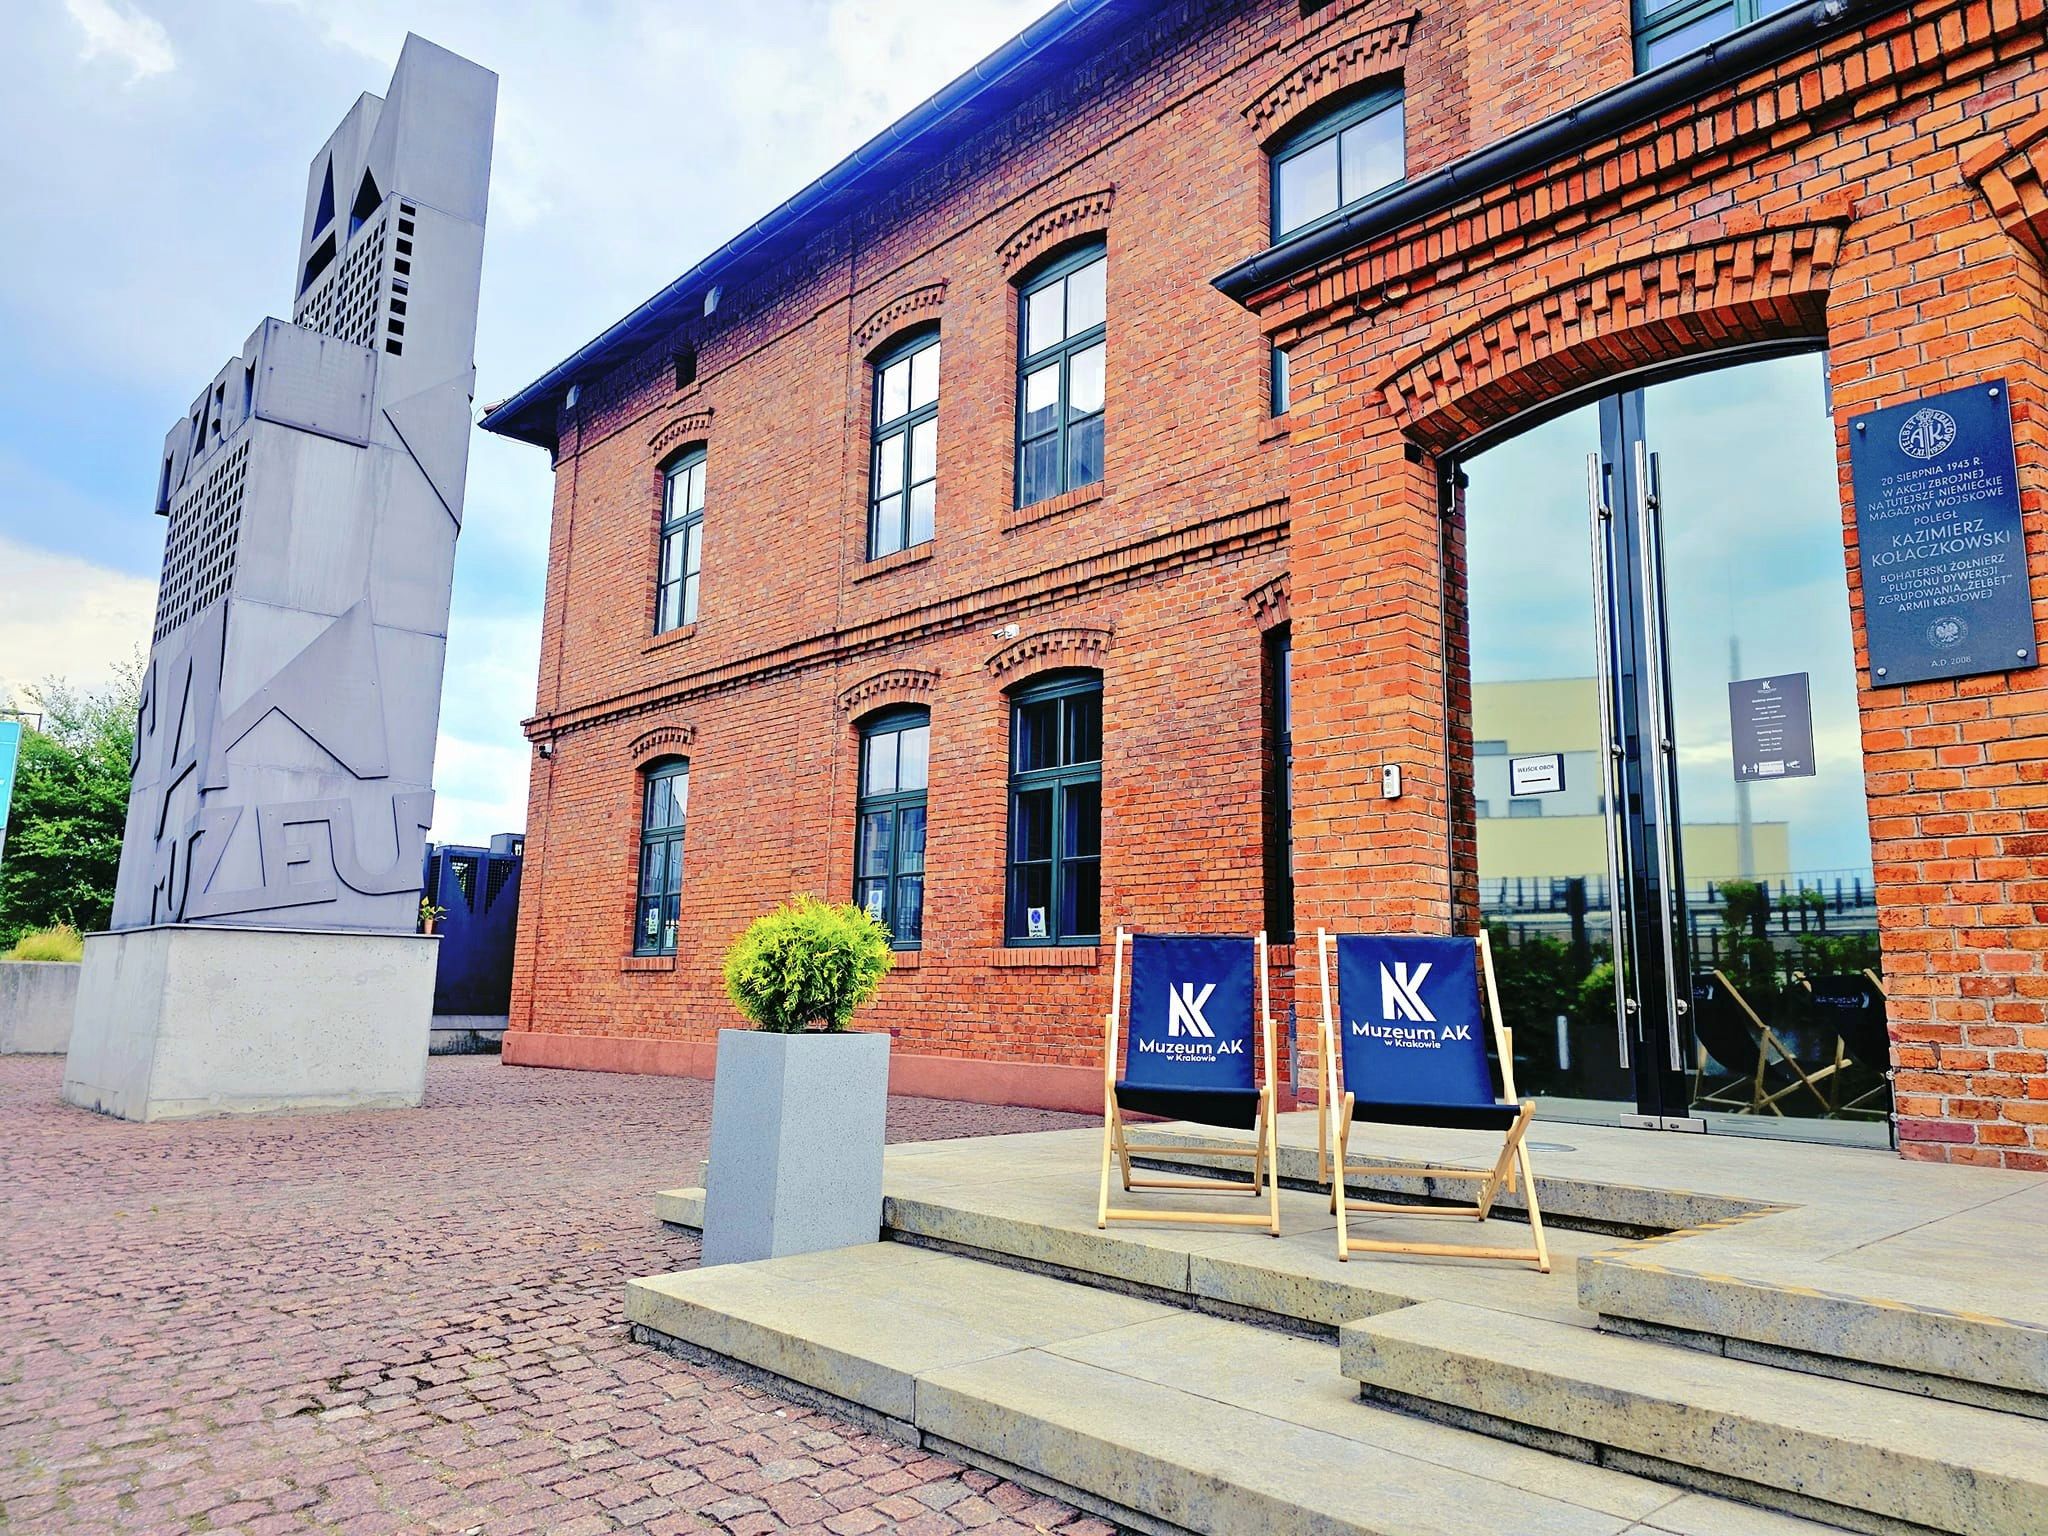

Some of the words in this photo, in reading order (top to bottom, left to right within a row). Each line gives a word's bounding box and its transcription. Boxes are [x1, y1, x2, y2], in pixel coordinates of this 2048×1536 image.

[1881, 476, 1893, 486] 20
[1896, 465, 1943, 483] SIERPNIA
[1973, 456, 1984, 466] R.
[1882, 488, 1893, 498] W
[1896, 482, 1926, 496] AKCJI
[1928, 468, 1985, 489] ZBROJNEJ
[1868, 501, 1884, 512] NA
[1886, 490, 1935, 508] TUTEJSZE
[1939, 475, 2003, 497] NIEMIECKIE
[1869, 501, 1932, 521] MAGAZYNY
[1935, 486, 2004, 508] WOJSKOWE
[1914, 510, 1959, 526] POLEGŁ
[1892, 518, 1985, 548] KAZIMIERZ
[1871, 529, 2011, 568] KOŁACZKOWSKI
[1880, 564, 1947, 584] BOHATERSKI
[1950, 553, 2006, 572] ŻOŁNIERZ
[1889, 577, 1940, 593] PLUTONU
[1943, 566, 1998, 584] DYWERSJI
[1878, 583, 1962, 605] ZGRUPOWANIA
[1898, 599, 1930, 613] ARMII
[1933, 589, 1993, 607] KRAJOWEJ
[1351, 1019, 1436, 1041] Muzeum
[1440, 1024, 1472, 1041] AK
[1139, 1038, 1213, 1054] Muzeum
[1217, 1039, 1244, 1054] AK
[1395, 1039, 1442, 1049] Krakowie
[1175, 1054, 1217, 1062] Krakowie
